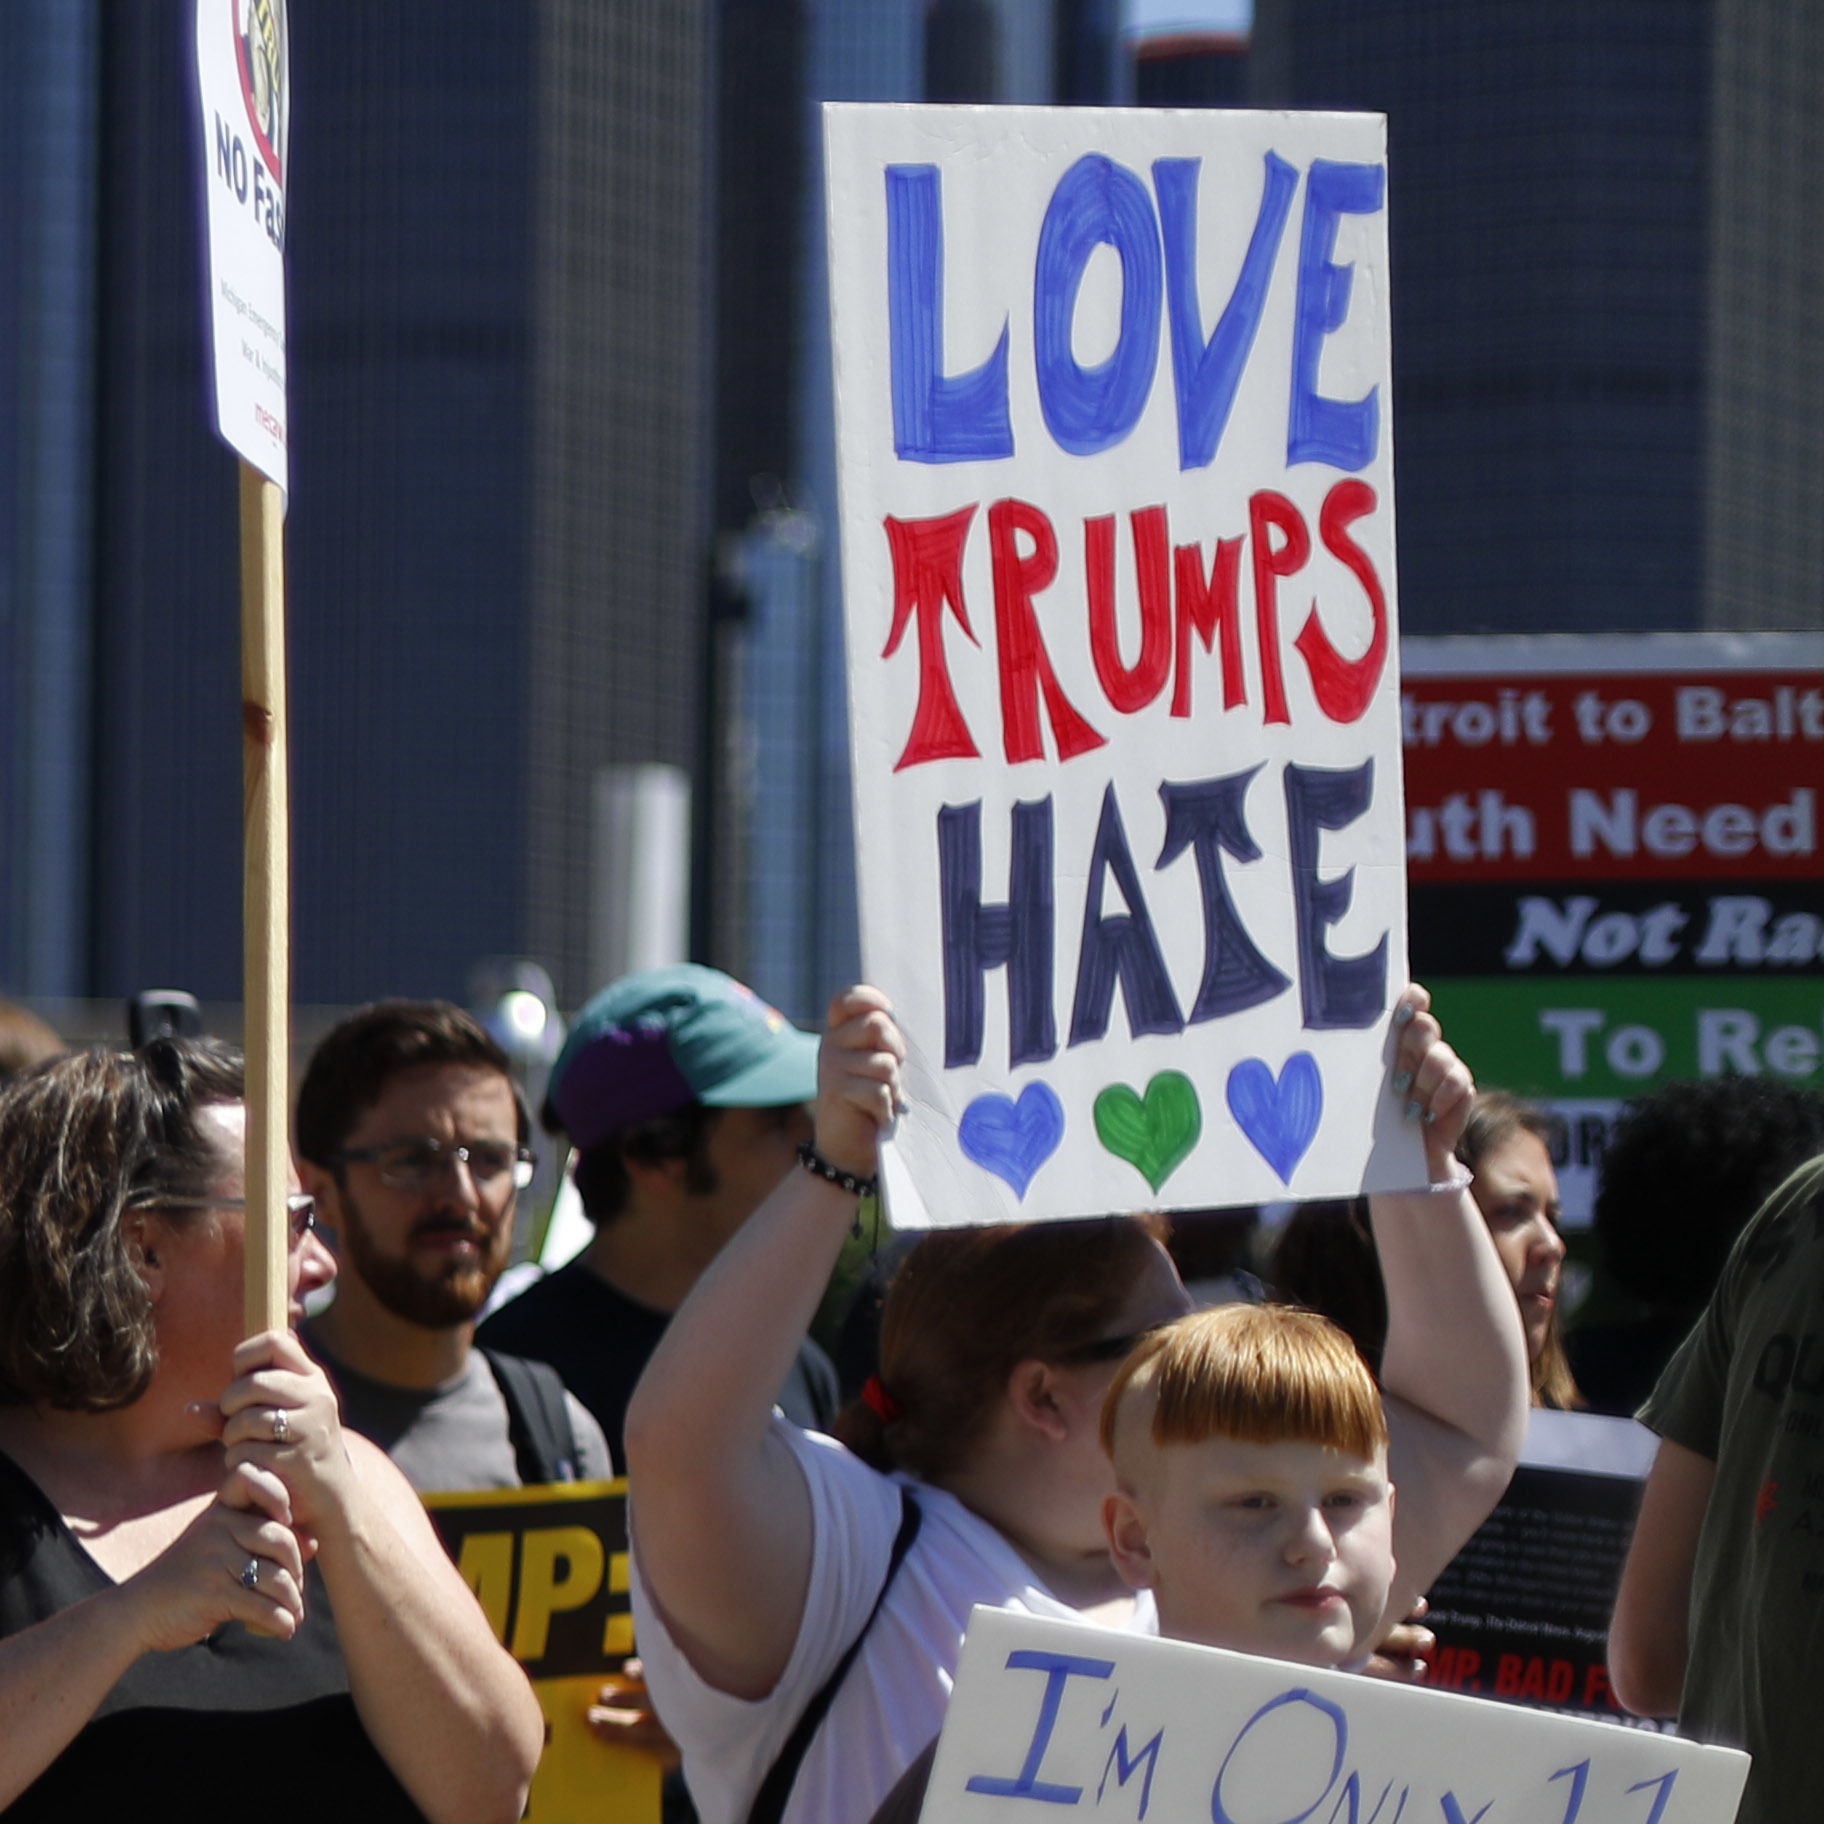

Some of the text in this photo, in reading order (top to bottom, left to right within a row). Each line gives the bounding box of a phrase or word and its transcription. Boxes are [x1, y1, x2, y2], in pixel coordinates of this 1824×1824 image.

[215, 109, 248, 205] NO
[885, 150, 1385, 472] LOVE
[881, 478, 1389, 772] TRUMPS
[1573, 690, 1652, 744] to
[1675, 685, 1824, 742] Balt
[1568, 786, 1816, 859] Need
[936, 757, 1389, 1072] HATE
[1505, 894, 1824, 968] Not Ra
[1539, 1008, 1824, 1079] To Re
[1494, 1652, 1575, 1705] BAD
[966, 1650, 1165, 1821] I'M
